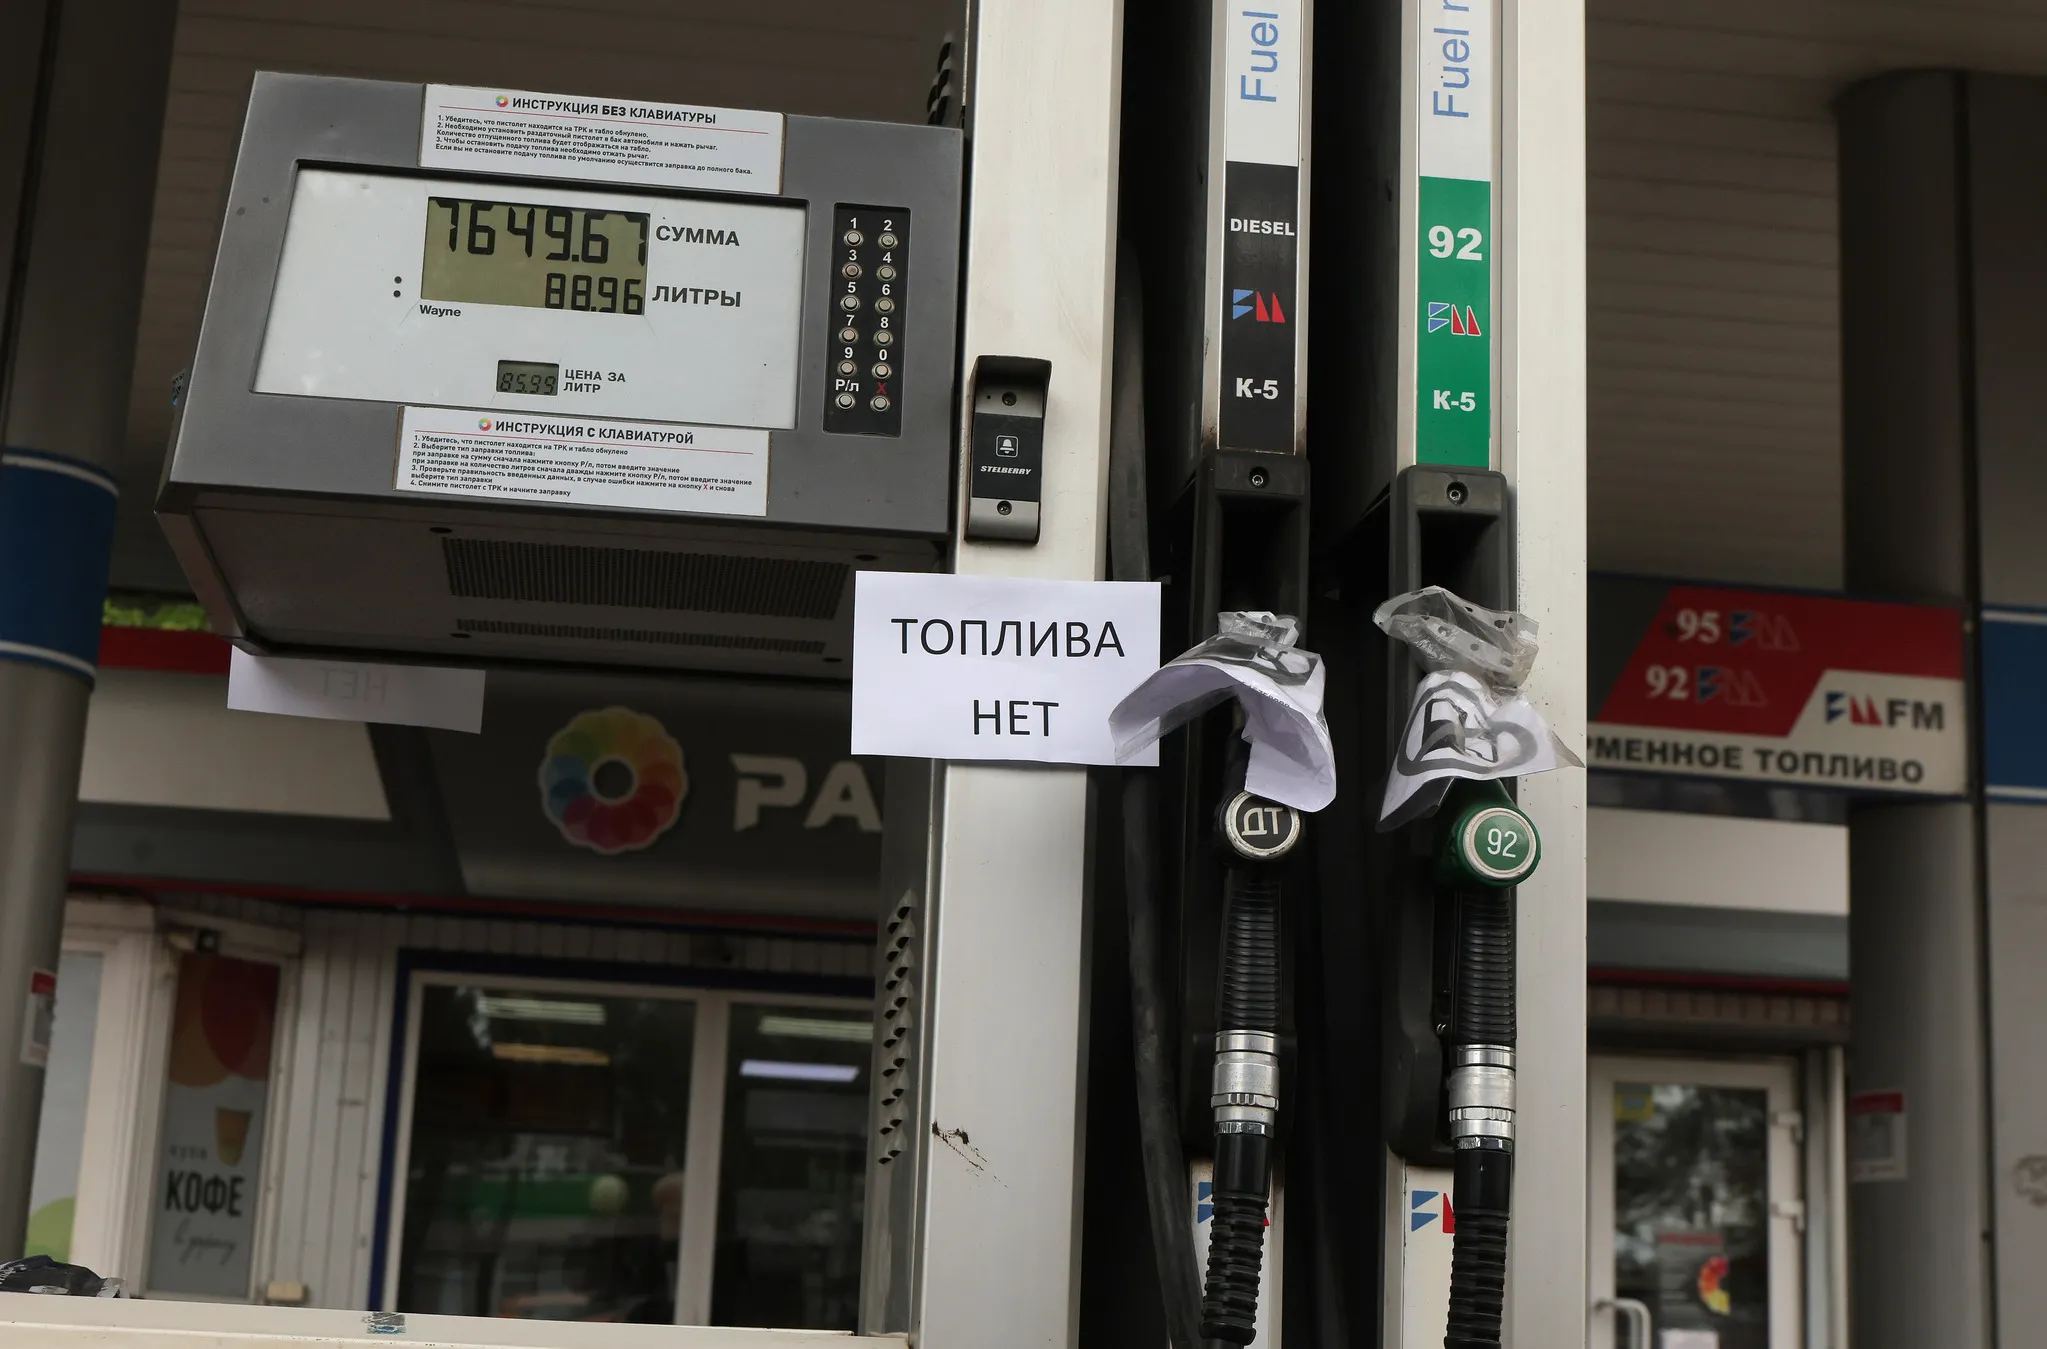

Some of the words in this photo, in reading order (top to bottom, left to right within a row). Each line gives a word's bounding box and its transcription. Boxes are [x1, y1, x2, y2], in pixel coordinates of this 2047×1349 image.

[1240, 11, 1279, 102] Fuel
[1433, 28, 1470, 118] Fuel
[512, 97, 598, 115] ИНСТРУКЦИЯ
[601, 105, 626, 116] БЕЗ
[629, 107, 716, 124] КЛАВИАТУРЫ
[444, 122, 486, 132] Необходимо
[487, 127, 525, 135] установить
[526, 129, 571, 139] раздаточный
[622, 137, 662, 145] автомобиля
[528, 123, 562, 131] находится
[436, 129, 476, 138] Количество
[477, 133, 521, 142] отпущенного
[552, 138, 570, 146] будет
[572, 140, 619, 150] отображаться
[473, 147, 512, 155] остановите
[513, 150, 537, 158] подачу
[577, 156, 615, 164] умолчанию
[616, 159, 663, 168] осуществится
[664, 163, 695, 171] заправка
[560, 146, 600, 156] необходимо
[850, 217, 858, 229] 1
[883, 220, 892, 231] 2
[1230, 218, 1295, 236] DIESEL
[655, 225, 740, 247] СУММА
[1428, 225, 1483, 261] 92
[849, 250, 857, 261] 3
[882, 252, 892, 263] 4
[848, 282, 856, 293] 5
[882, 284, 890, 295] 6
[652, 285, 741, 308] ЛИТРЫ
[419, 304, 461, 318] Wayne
[846, 315, 855, 326] 7
[880, 317, 889, 328] 8
[844, 347, 853, 359] 9
[879, 349, 887, 361] 0
[565, 369, 602, 381] ЦЕНА
[607, 372, 626, 383] ЗА
[563, 382, 601, 393] ЛИТР
[835, 379, 859, 392] Р/л
[495, 420, 583, 438] ИНСТРУКЦИЯ
[598, 426, 693, 444] КЛАВИАТУРОЙ
[421, 443, 455, 451] Выберите
[471, 447, 503, 455] заправки
[427, 451, 459, 459] заправке
[595, 447, 628, 456] обнулено
[426, 458, 458, 466] заправке
[470, 461, 509, 469] количество
[980, 465, 1032, 475] STELBERRY
[410, 472, 444, 480] выберите
[460, 476, 492, 484] заправки
[419, 465, 456, 474] Проверьте
[457, 468, 505, 477] правильность
[506, 471, 545, 479] введенных
[607, 477, 634, 485] ошибки
[418, 479, 448, 487] Снимите
[538, 489, 570, 497] заправку
[1675, 608, 1721, 644] 95
[891, 618, 1125, 658] ТОПЛИВА
[1645, 665, 1691, 700] 92
[973, 700, 1059, 737] НЕТ
[1887, 699, 1945, 731] FM
[1754, 748, 1925, 785] ТОПЛИВО
[1241, 807, 1284, 836] ДТ
[1486, 828, 1517, 858] 92
[165, 1168, 245, 1217] КОФЕ
